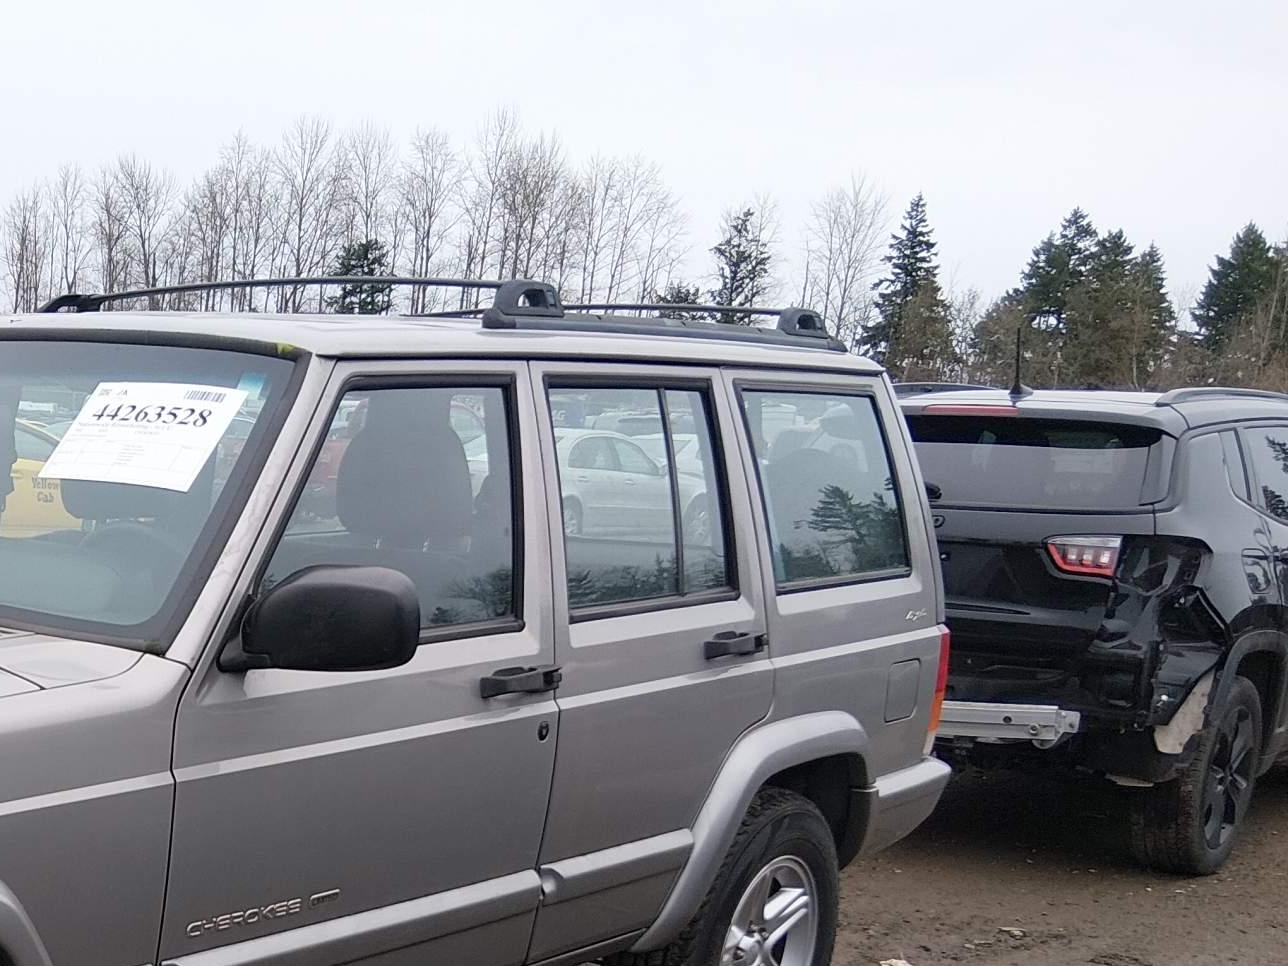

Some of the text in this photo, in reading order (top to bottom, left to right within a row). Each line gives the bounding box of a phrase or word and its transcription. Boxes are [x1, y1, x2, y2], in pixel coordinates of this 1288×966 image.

[92, 403, 213, 428] 44263528
[36, 491, 55, 503] Cab
[186, 897, 303, 937] CHEROKEE
